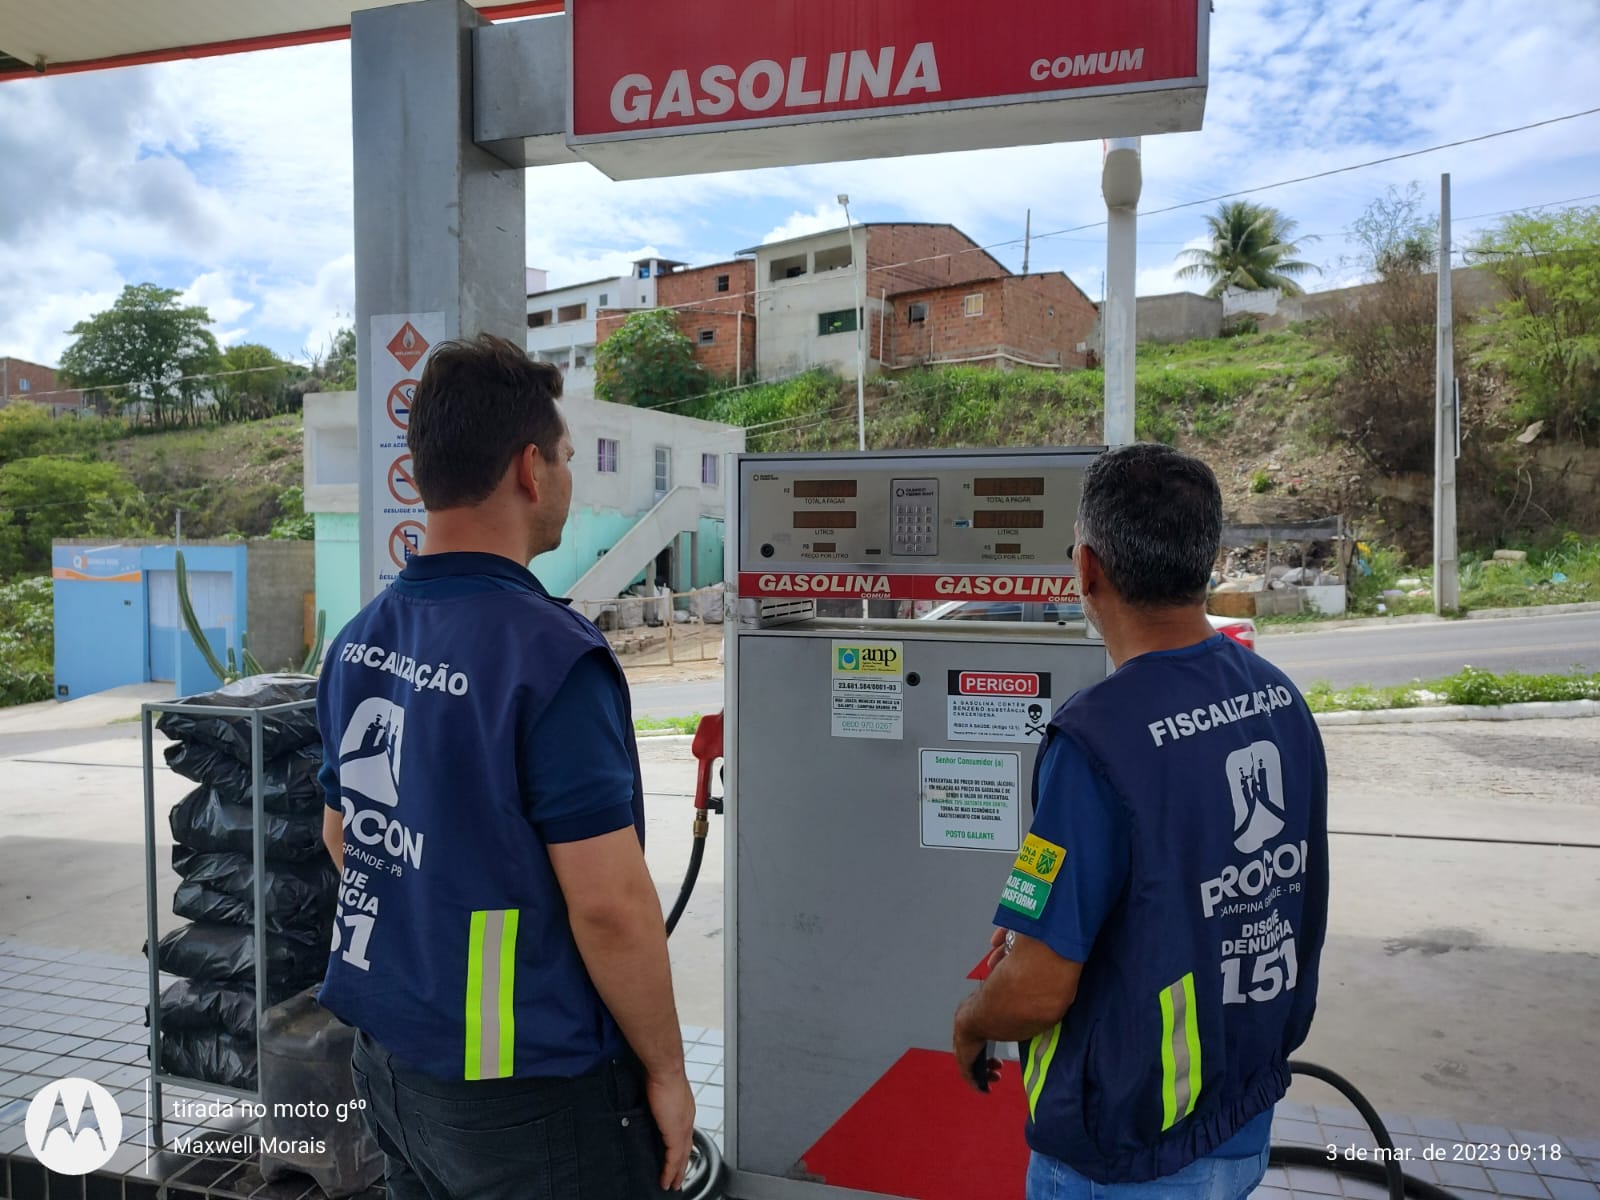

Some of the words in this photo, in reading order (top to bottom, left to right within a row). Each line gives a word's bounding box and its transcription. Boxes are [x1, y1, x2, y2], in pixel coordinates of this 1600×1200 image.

[1029, 47, 1145, 81] COMUM
[609, 42, 942, 124] GASOLINA
[758, 574, 892, 593] GASOLINA
[934, 576, 1081, 596] GASOLINA
[861, 647, 897, 667] anp
[965, 677, 1032, 693] PERIGO!
[1147, 683, 1293, 748] FISCALIZAÇÃO
[935, 755, 956, 764] Senhor
[957, 756, 993, 767] Consumidor
[945, 829, 966, 839] POSTO
[966, 830, 995, 840] GALANTE
[391, 865, 402, 877] PB
[1020, 880, 1037, 897] QUE
[1289, 881, 1301, 895] PB
[1220, 937, 1299, 1006] 151
